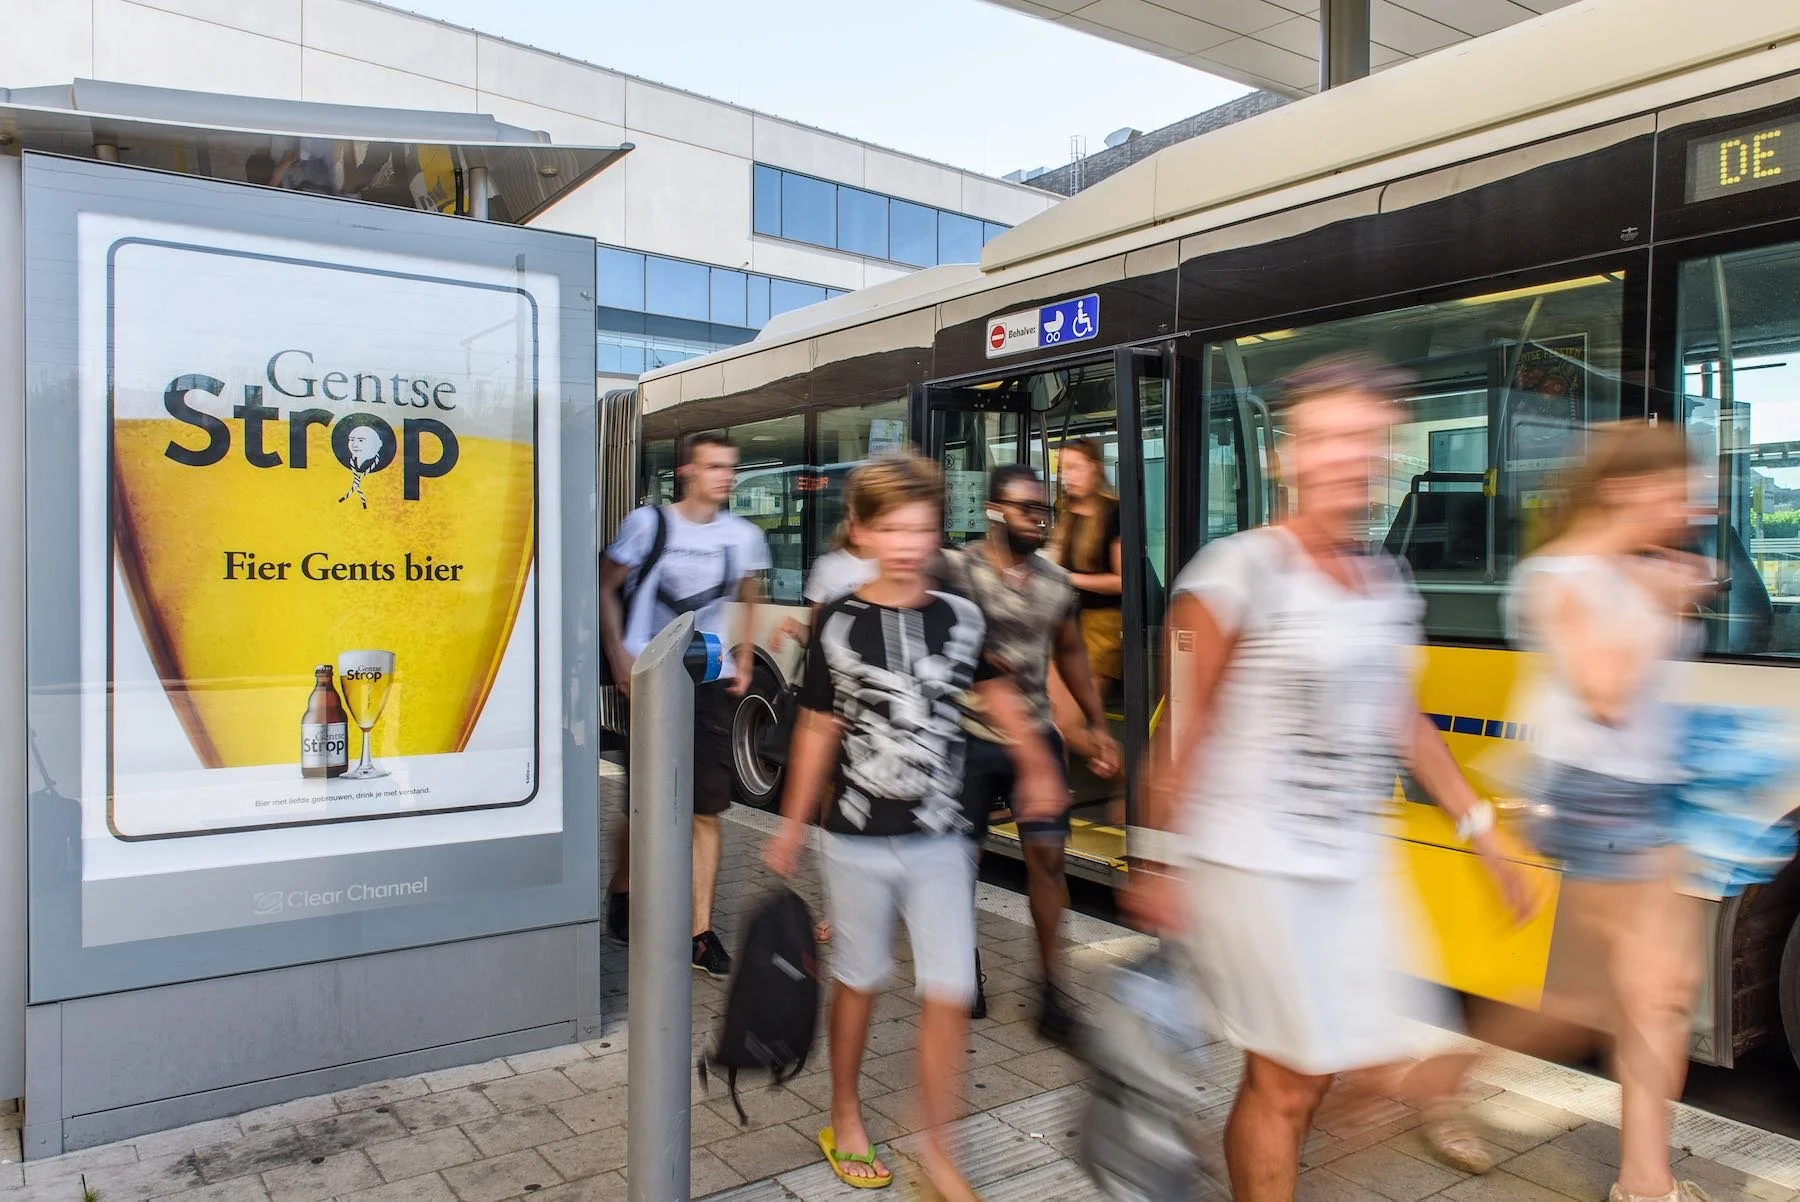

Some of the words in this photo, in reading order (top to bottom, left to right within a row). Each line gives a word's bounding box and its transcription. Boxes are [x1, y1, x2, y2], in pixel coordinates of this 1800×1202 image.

[1720, 130, 1781, 186] DE
[1008, 326, 1036, 339] Behalve:
[266, 349, 458, 412] Gentse
[163, 373, 460, 501] Strop
[222, 551, 292, 581] Fier
[301, 552, 396, 582] Gents
[404, 552, 464, 582] bier
[346, 669, 382, 683] Strop
[357, 664, 382, 673] Gentse
[303, 738, 345, 756] Strop
[255, 800, 271, 808] Bier
[288, 796, 310, 805] liefde
[311, 794, 355, 805] gebrouwen,
[355, 791, 374, 800] drink
[375, 791, 382, 799] je
[383, 789, 398, 797] met
[398, 787, 431, 796] verstand.
[287, 890, 343, 908] Clear
[347, 876, 428, 902] Channel
